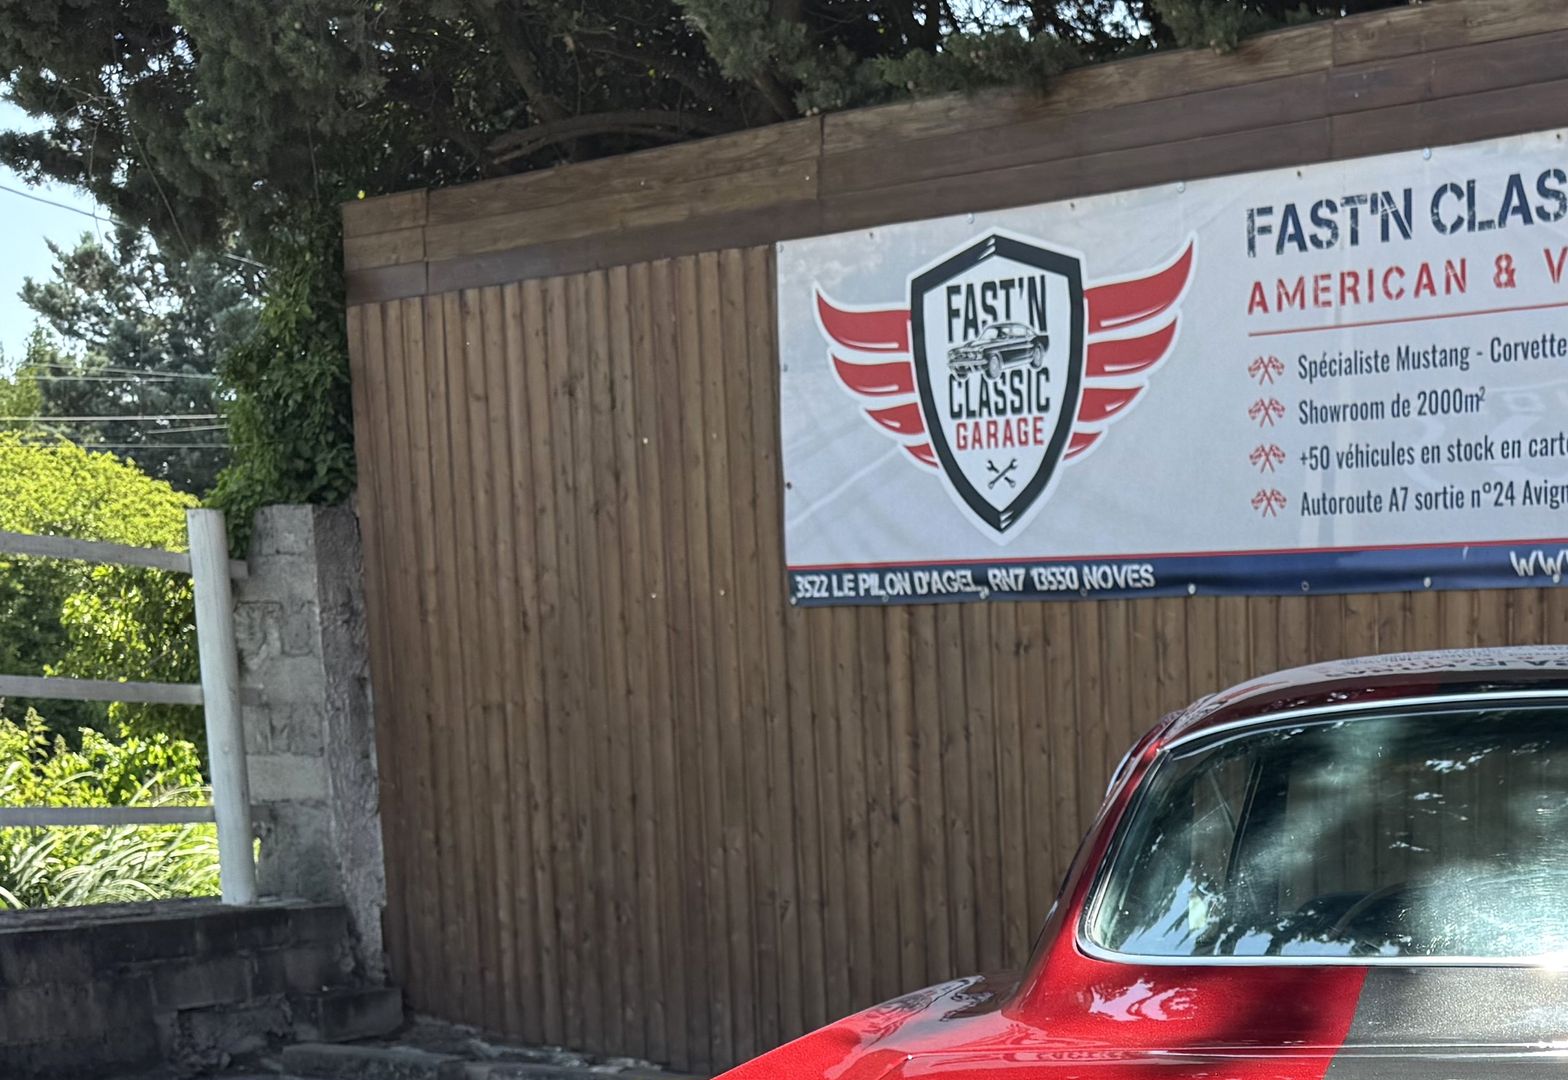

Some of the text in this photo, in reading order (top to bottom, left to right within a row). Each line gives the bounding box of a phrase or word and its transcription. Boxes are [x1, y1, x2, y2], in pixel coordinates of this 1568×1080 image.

[1246, 187, 1412, 258] FAST'N
[1247, 257, 1467, 315] AMERICAN
[1493, 252, 1516, 289] &
[946, 274, 1047, 343] FAST'N
[1298, 350, 1390, 383] Spécialiste
[1396, 344, 1470, 371] Mustang
[1490, 332, 1567, 363] Corvette
[949, 366, 1050, 419] CLASSIC
[1298, 386, 1486, 425] Showroom de 2000m²
[956, 415, 1045, 451] GARAGE
[1299, 445, 1331, 471] +50
[1336, 440, 1415, 470] véhicules
[1421, 444, 1441, 464] en
[1447, 434, 1494, 463] stock
[1501, 438, 1521, 460] en
[1301, 489, 1383, 517] Autoroute
[1389, 486, 1409, 513] A7
[1415, 485, 1465, 511] sortie
[794, 574, 829, 598] 3522
[831, 573, 856, 597] LE
[857, 570, 913, 597] PILON
[987, 567, 1025, 592] RN7
[1030, 566, 1080, 591] 13550
[1082, 564, 1156, 590] NOVES
